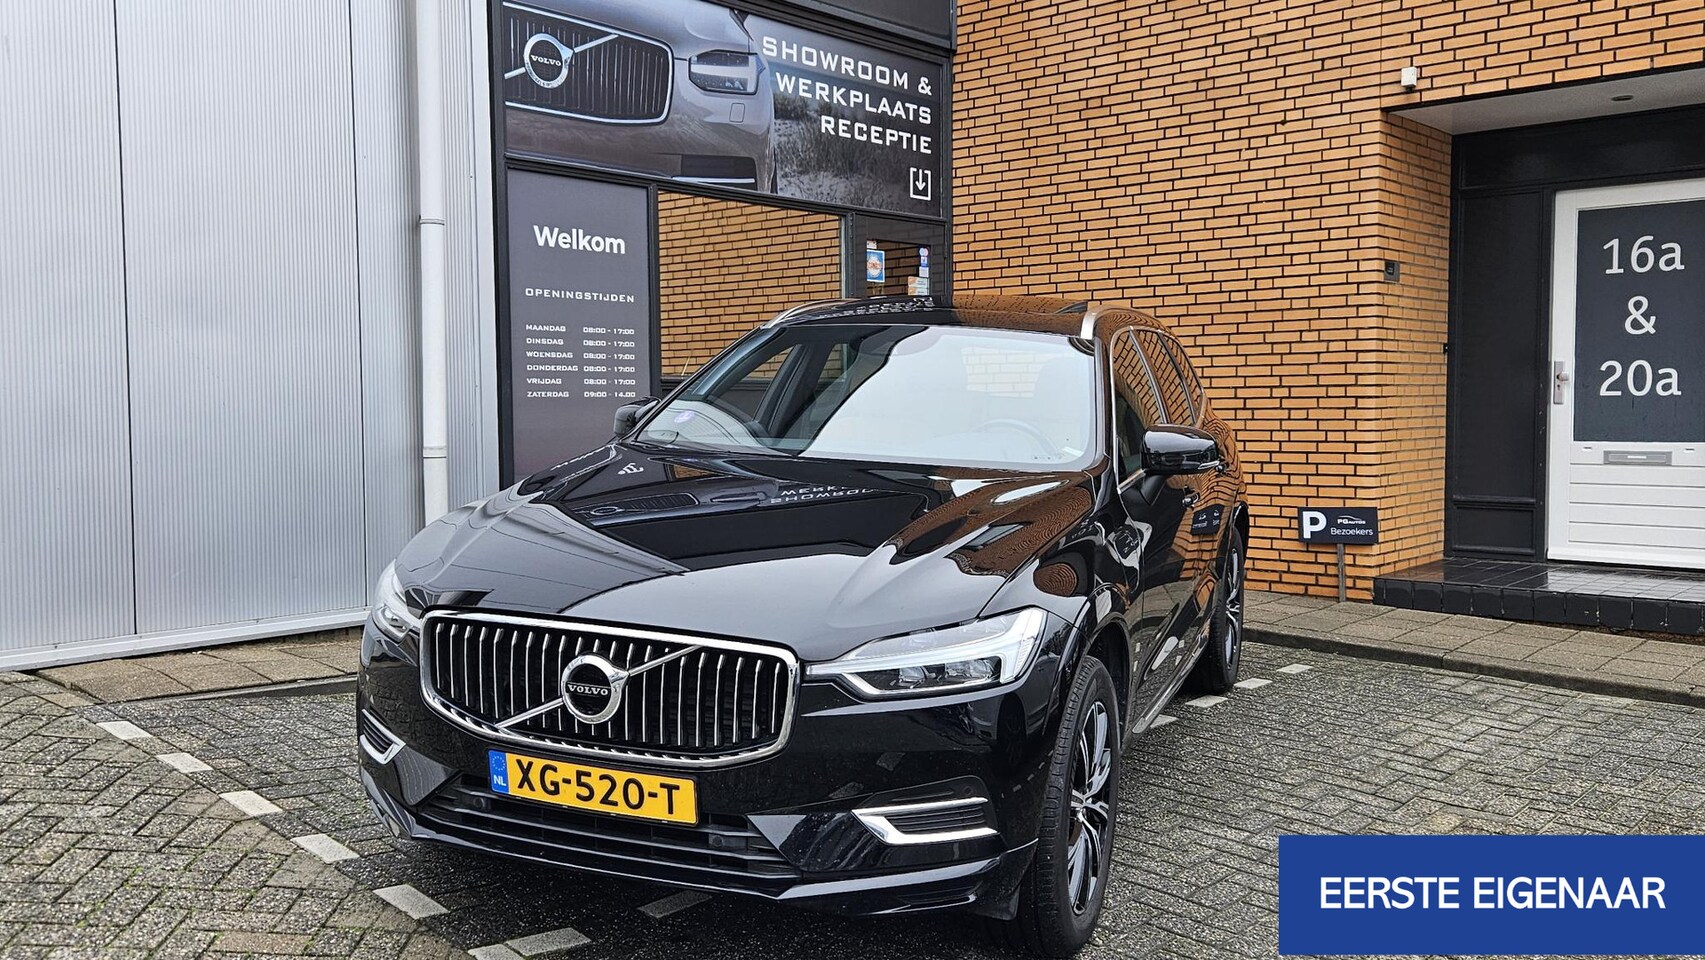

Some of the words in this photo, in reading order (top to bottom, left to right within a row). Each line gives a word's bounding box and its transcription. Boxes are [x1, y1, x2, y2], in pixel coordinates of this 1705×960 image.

[530, 54, 562, 67] VOLVO
[762, 36, 908, 90] SHOWROOM
[918, 76, 932, 95] &
[776, 72, 932, 125] WERKPLAATS
[822, 115, 932, 155] RECEPTIE
[533, 225, 626, 254] Welkom
[1603, 235, 1685, 274] 16a
[525, 287, 634, 303] OPENINGSTIJDEN
[1624, 295, 1657, 335] &
[525, 324, 566, 333] MAANDAG
[526, 337, 564, 345] DINSDAG
[526, 351, 573, 359] WOENSDAG
[526, 364, 578, 372] DONDERDAG
[1599, 359, 1682, 396] 20a
[1302, 511, 1327, 539] P
[1330, 527, 1374, 536] Bezoekers
[567, 684, 609, 696] VOLVO
[493, 774, 507, 787] NL
[515, 758, 680, 815] XG-520-T
